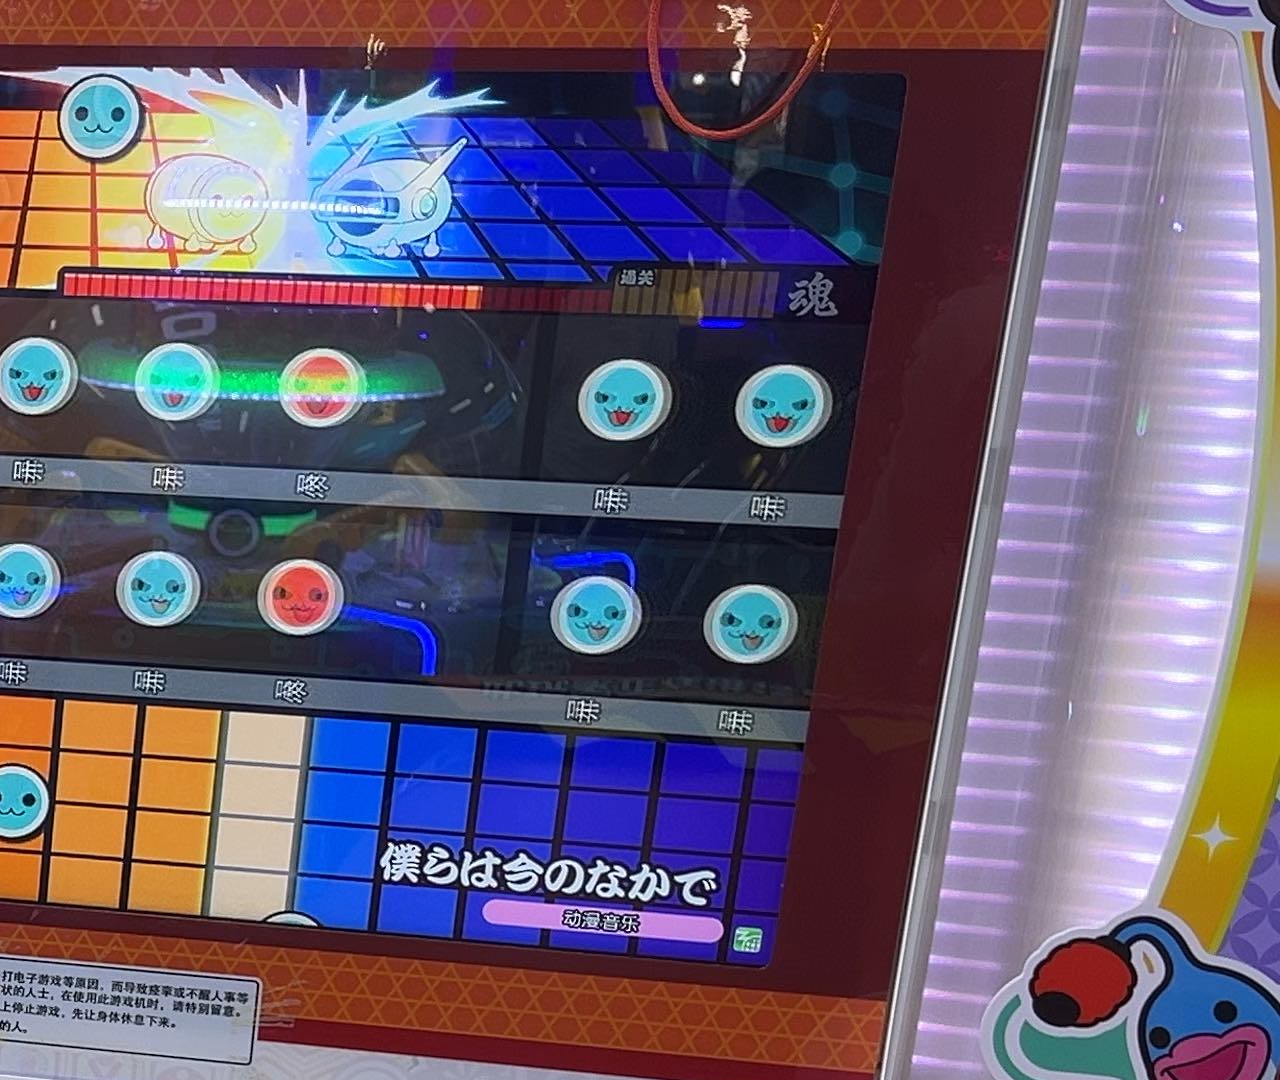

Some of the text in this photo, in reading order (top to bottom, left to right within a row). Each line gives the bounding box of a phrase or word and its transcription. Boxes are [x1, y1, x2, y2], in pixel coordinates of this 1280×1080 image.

[787, 272, 839, 317] 魂
[379, 841, 717, 907] 僕らは今のなかで
[561, 907, 642, 932] 动漫音乐
